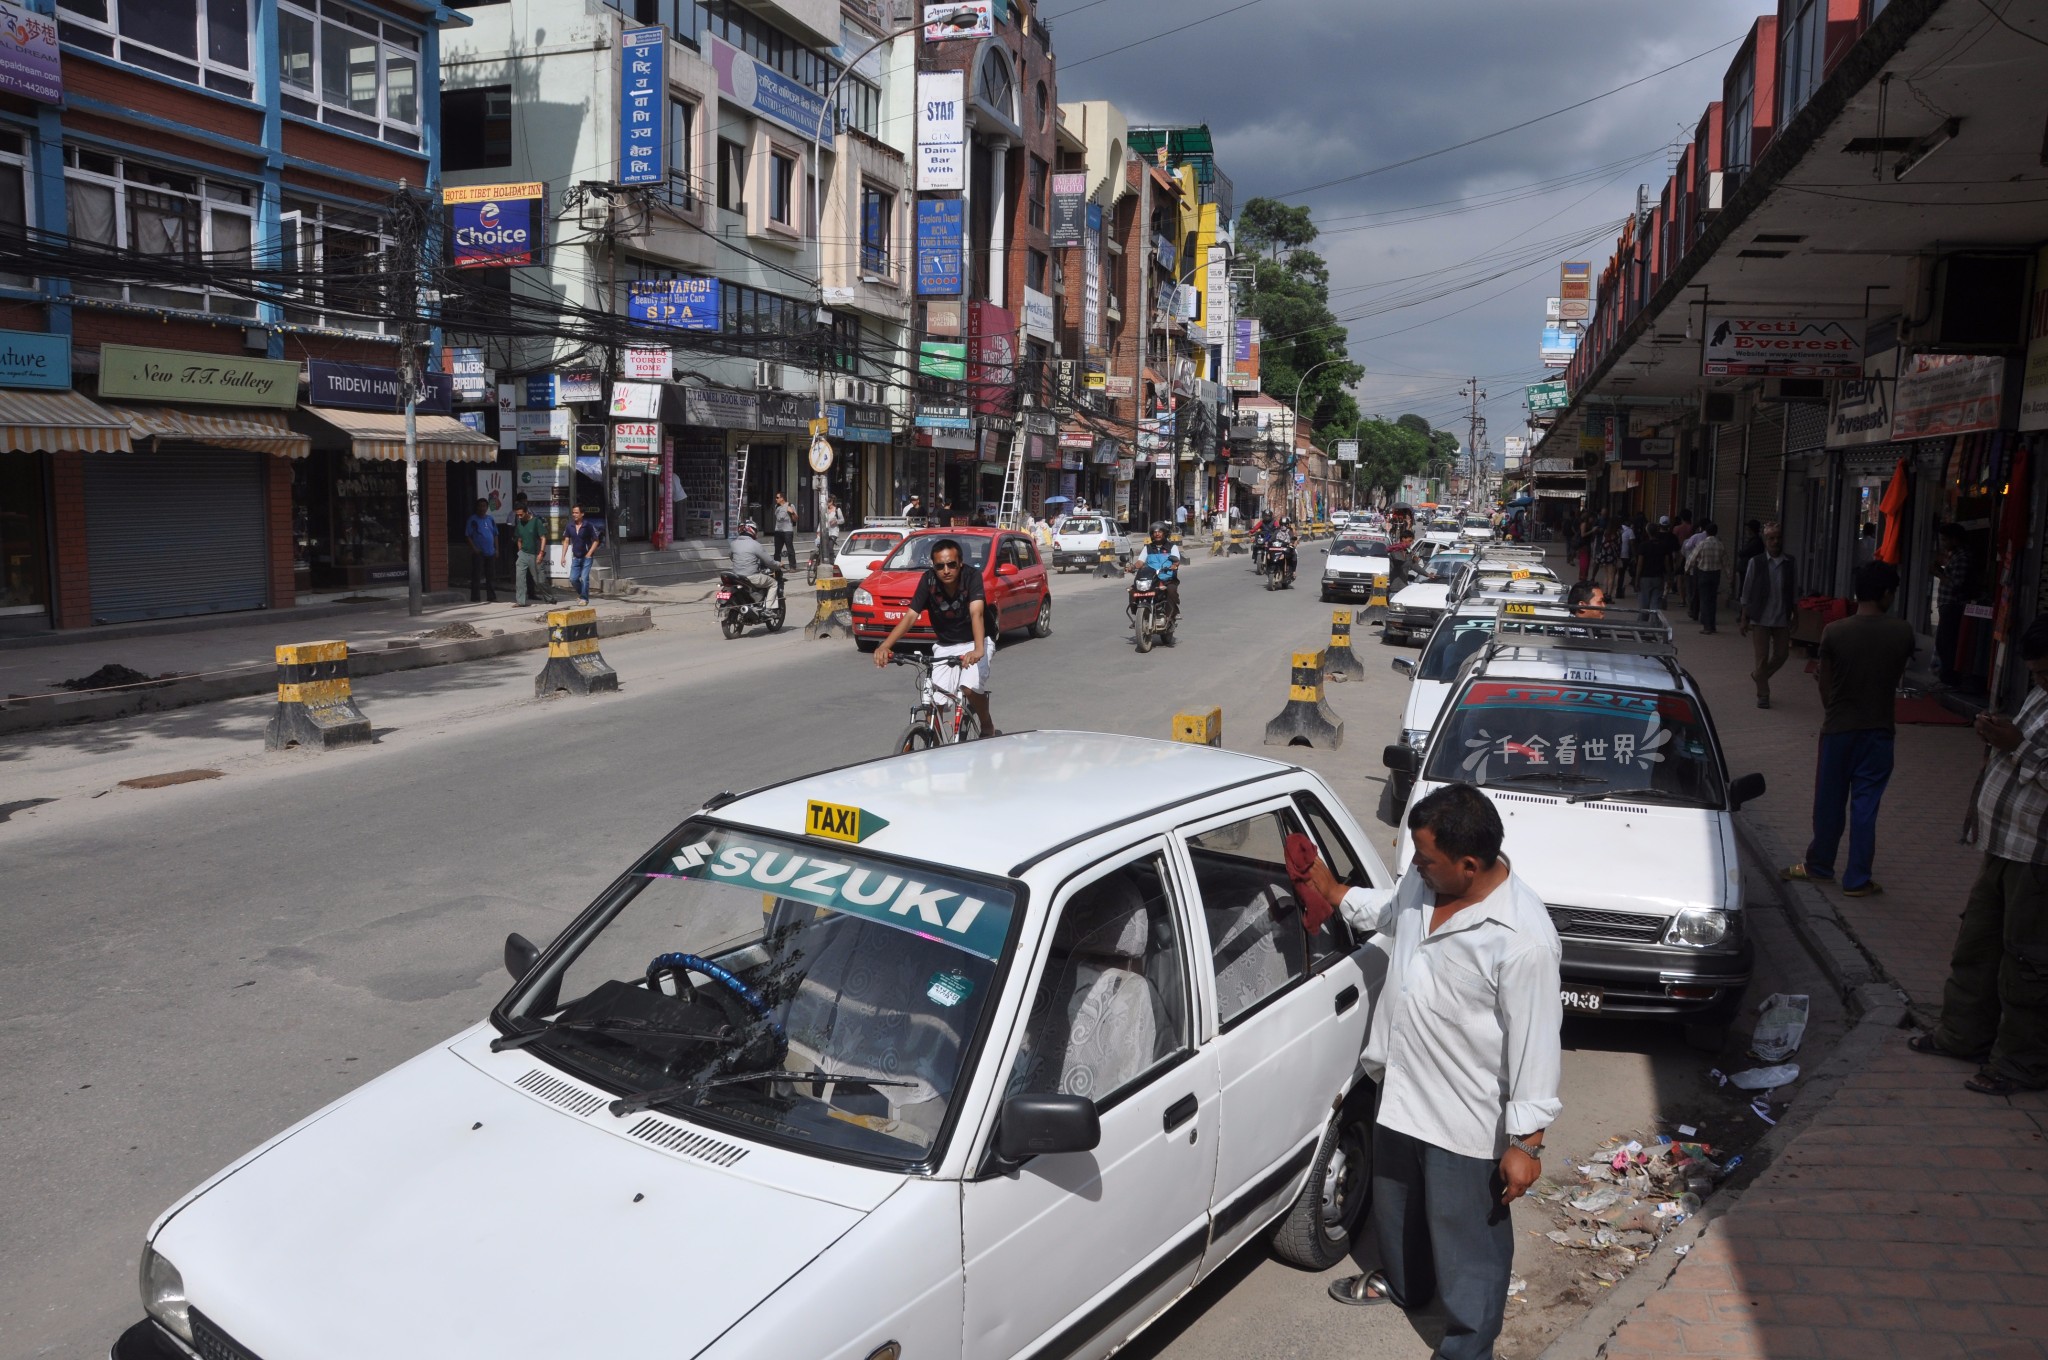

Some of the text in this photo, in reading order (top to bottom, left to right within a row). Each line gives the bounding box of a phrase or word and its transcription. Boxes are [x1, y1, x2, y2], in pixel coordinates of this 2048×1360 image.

[927, 101, 954, 121] STAR
[931, 132, 951, 141] GIN
[930, 156, 951, 164] Bar
[445, 184, 542, 201] HOTEL TIBET HOLIDAY INN
[1055, 184, 1083, 193] PHOTO
[919, 214, 942, 226] Explore
[456, 225, 527, 246] Choice
[635, 293, 706, 306] Beauty and Hair Care
[646, 305, 694, 319] SPA
[1735, 320, 1798, 332] Yeti
[1734, 337, 1852, 350] Everest
[1769, 351, 1848, 359] www.yetieverest.com
[453, 361, 484, 374] WALKERS
[133, 363, 274, 394] New T.T. Gallery
[328, 375, 371, 393] TRIDEVI
[453, 376, 485, 390] EXPEDITION
[693, 390, 757, 408] THAMEL BOOK SHOP
[780, 401, 798, 415] NPI
[923, 406, 955, 415] MILLET
[761, 413, 775, 428] Nepal
[855, 410, 877, 423] MILLET
[1836, 406, 1884, 436] Everest
[616, 423, 657, 436] STAR
[616, 436, 631, 444] TOURS
[636, 436, 658, 445] TRAVELS
[1031, 484, 1040, 516] MONEY
[1218, 481, 1227, 512] Marmot
[860, 532, 902, 541] SUZUKI
[1350, 534, 1386, 542] SUZUKI
[1512, 569, 1530, 580] TAXI
[1504, 688, 1657, 712] SPORTS
[1493, 733, 1635, 765] 千金看世界
[810, 804, 858, 837] TAXI
[711, 846, 985, 934] SUZUKI
